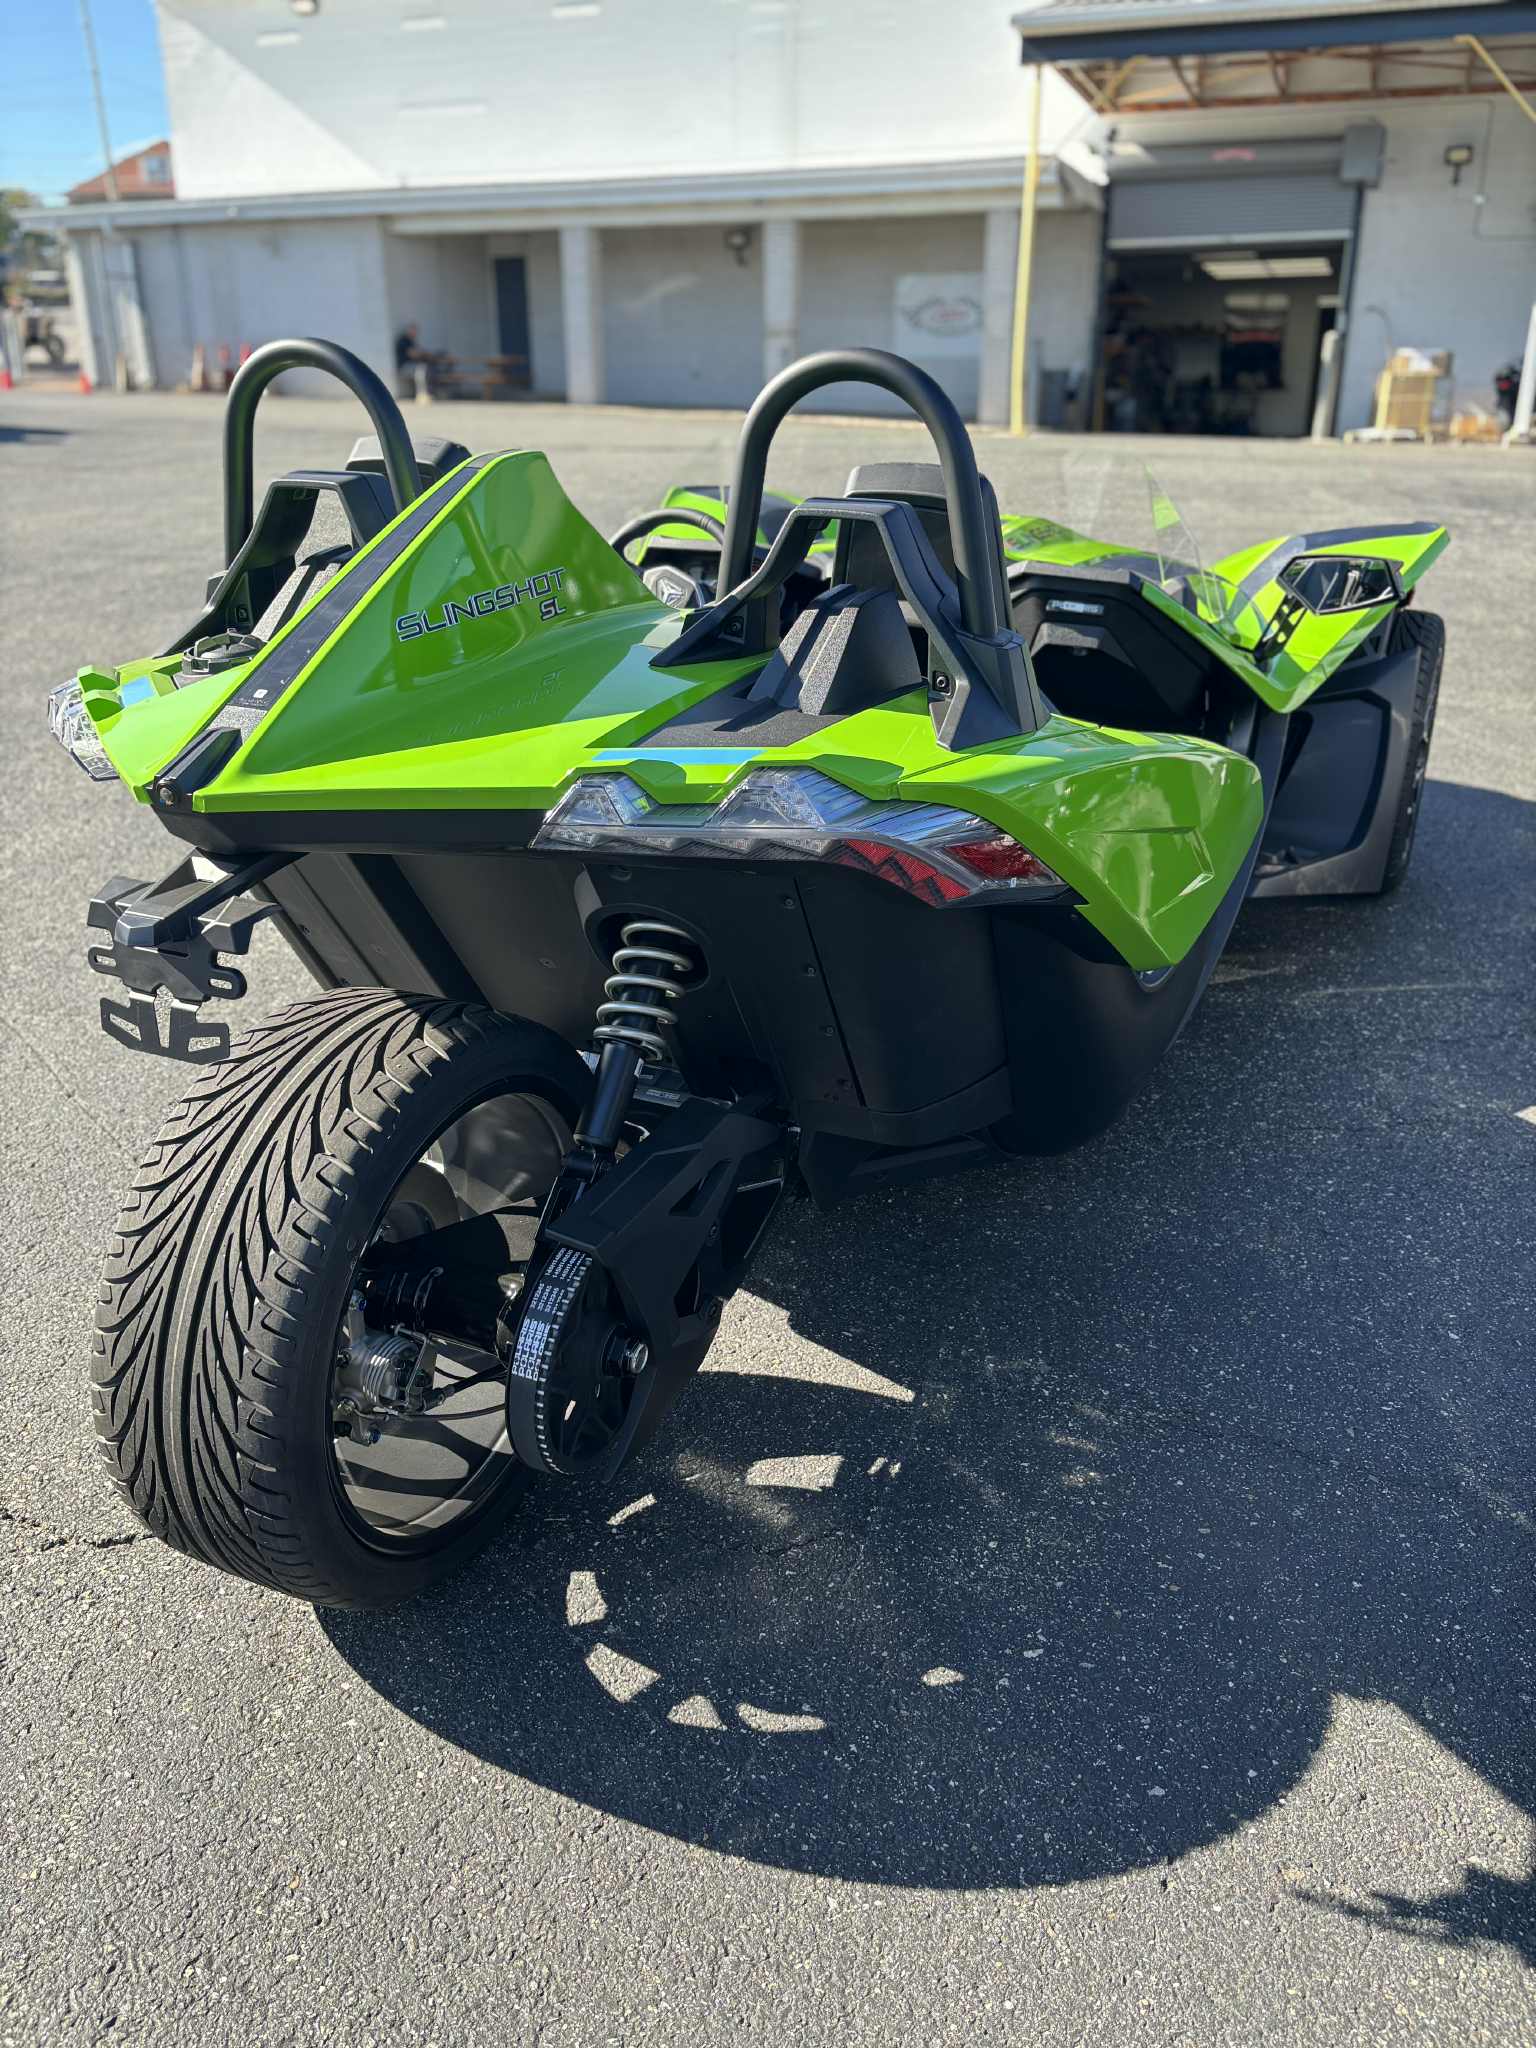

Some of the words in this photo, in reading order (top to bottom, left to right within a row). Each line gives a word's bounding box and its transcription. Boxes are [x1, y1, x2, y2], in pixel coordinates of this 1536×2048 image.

[395, 566, 566, 642] SLINGSHOT
[539, 595, 568, 622] SL
[511, 1315, 531, 1376] POLARIS
[518, 1318, 538, 1378] POLARIS
[525, 1320, 546, 1380] POLARIS
